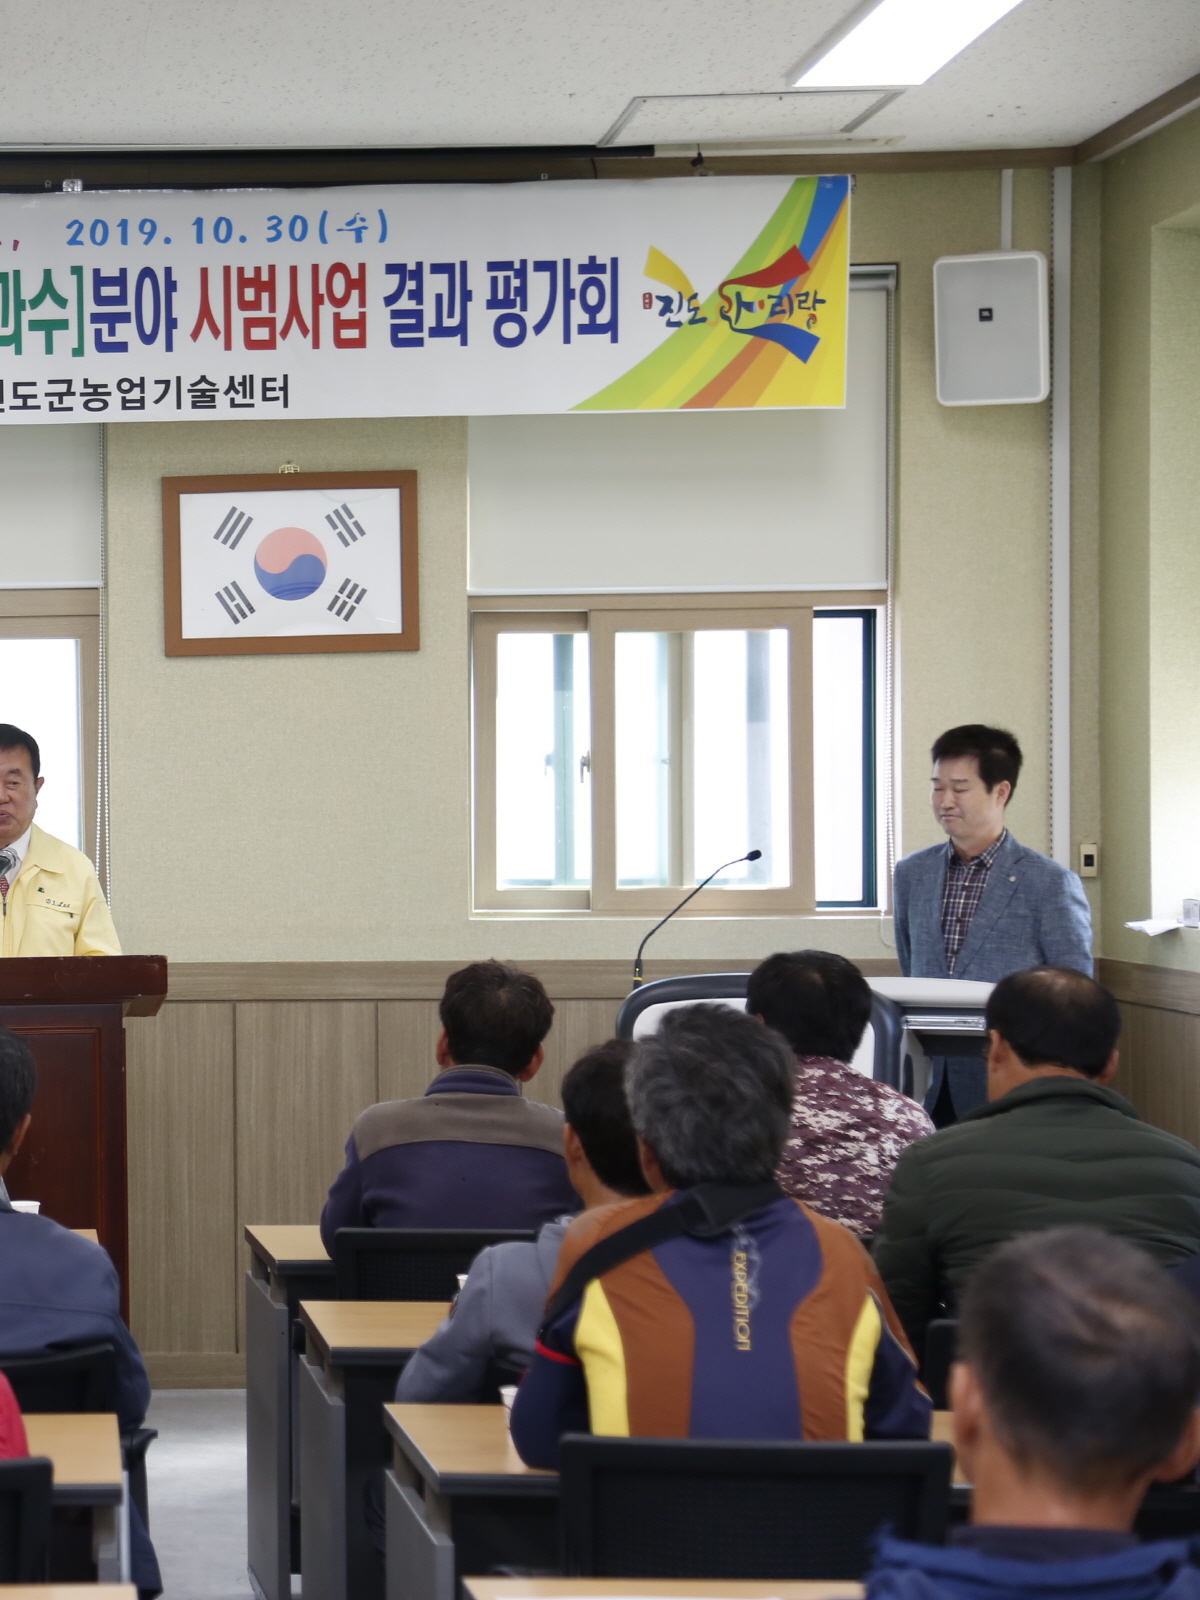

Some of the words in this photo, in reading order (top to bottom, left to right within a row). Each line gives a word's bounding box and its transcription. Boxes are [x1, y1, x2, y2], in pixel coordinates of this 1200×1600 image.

[66, 218, 172, 246] 2019.
[193, 216, 247, 245] 10.
[266, 209, 388, 245] 30(수)
[190, 261, 368, 352] 시범사업
[383, 260, 473, 349] 결과
[486, 255, 619, 349] 평가회
[655, 291, 708, 328] 진도
